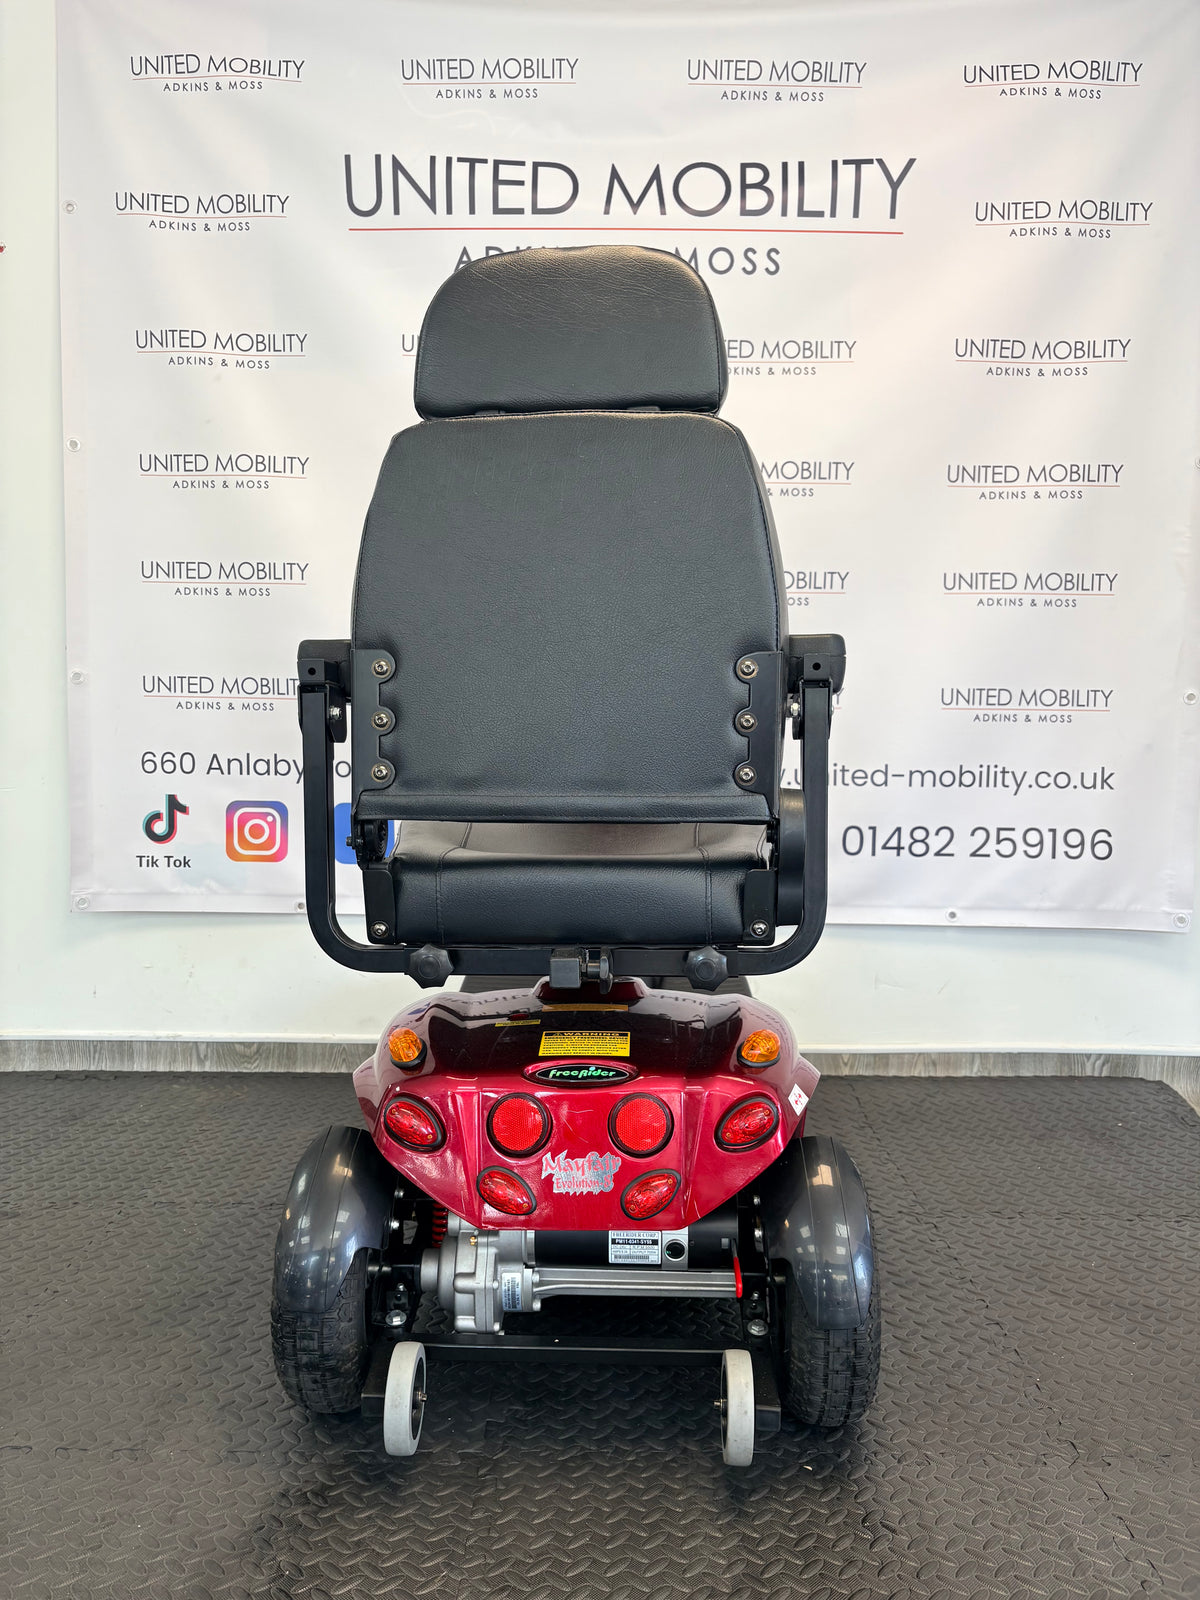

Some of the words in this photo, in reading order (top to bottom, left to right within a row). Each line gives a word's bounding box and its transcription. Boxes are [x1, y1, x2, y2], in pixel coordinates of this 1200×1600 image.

[131, 54, 201, 77] UNITED
[207, 55, 305, 79] MOBILITY
[401, 59, 475, 80] UNITED
[482, 58, 578, 79] MOBILITY
[688, 59, 763, 82] UNITED
[769, 61, 867, 84] MOBILITY
[964, 64, 1040, 83] UNITED
[1047, 60, 1144, 83] MOBILITY
[163, 82, 208, 91] ADKINS
[216, 82, 222, 91] &
[229, 81, 262, 90] MOSS
[436, 89, 482, 98] ADKINS
[489, 89, 496, 98] &
[504, 88, 537, 98] MOSS
[721, 90, 767, 101] ADKINS
[775, 92, 782, 101] &
[789, 92, 823, 101] MOSS
[1000, 86, 1048, 96] ADKINS
[1055, 88, 1061, 96] &
[1069, 88, 1101, 99] MOSS
[344, 154, 579, 217] UNITED
[604, 158, 916, 219] MOBILITY
[116, 192, 189, 213] UNITED
[197, 194, 289, 214] MOBILITY
[976, 201, 1051, 221] UNITED
[1058, 200, 1153, 222] MOBILITY
[149, 220, 197, 231] ADKINS
[204, 223, 211, 231] &
[218, 222, 250, 231] MOSS
[1010, 227, 1057, 237] ADKINS
[1065, 228, 1071, 236] &
[1079, 228, 1112, 238] MOSS
[136, 330, 206, 352] UNITED
[214, 333, 307, 352] MOBILITY
[761, 340, 856, 359] MOBILITY
[956, 339, 1025, 359] UNITED
[1032, 339, 1131, 360] MOBILITY
[169, 356, 213, 365] ADKINS
[221, 359, 228, 367] &
[236, 360, 269, 369] MOSS
[727, 366, 761, 376] DKINS
[768, 367, 774, 375] &
[782, 367, 816, 375] MOSS
[987, 367, 1030, 376] ADKINS
[1052, 367, 1087, 376] MOSS
[140, 454, 208, 472] UNITED
[215, 454, 309, 474] MOBILITY
[761, 461, 855, 480] MOBILITY
[948, 465, 1019, 483] UNITED
[1027, 464, 1124, 483] MOBILITY
[173, 480, 215, 488] ADKINS
[236, 480, 269, 489] MOSS
[780, 488, 814, 497] MOSS
[979, 491, 1026, 500] ADKINS
[1034, 491, 1040, 499] &
[1048, 490, 1082, 499] MOSS
[142, 561, 211, 579] UNITED
[219, 562, 308, 580] MOBILITY
[784, 571, 850, 589] OBILITY
[944, 572, 1017, 590] UNITED
[1024, 573, 1118, 591] MOBILITY
[175, 587, 218, 596] ADKINS
[226, 588, 232, 596] &
[239, 588, 270, 596] MOSS
[787, 597, 809, 606] OSS
[977, 598, 1023, 607] ADKINS
[1030, 599, 1037, 607] &
[1044, 599, 1076, 607] MOSS
[143, 676, 214, 693] UNITED
[221, 677, 299, 695] MOBILIT
[176, 701, 220, 710] ADKINS
[242, 703, 274, 711] MOSS
[942, 688, 1012, 706] UNITED
[1019, 689, 1113, 707] MOBILITY
[973, 714, 1017, 722] ADKINS
[1038, 714, 1072, 723] MOSS
[142, 752, 195, 774] 660
[206, 753, 304, 784] Anlaby
[842, 826, 954, 857] 01482
[969, 827, 1112, 860] 259196
[136, 856, 159, 867] Tik
[164, 856, 191, 868] Tok
[544, 1153, 620, 1177] Mayfair
